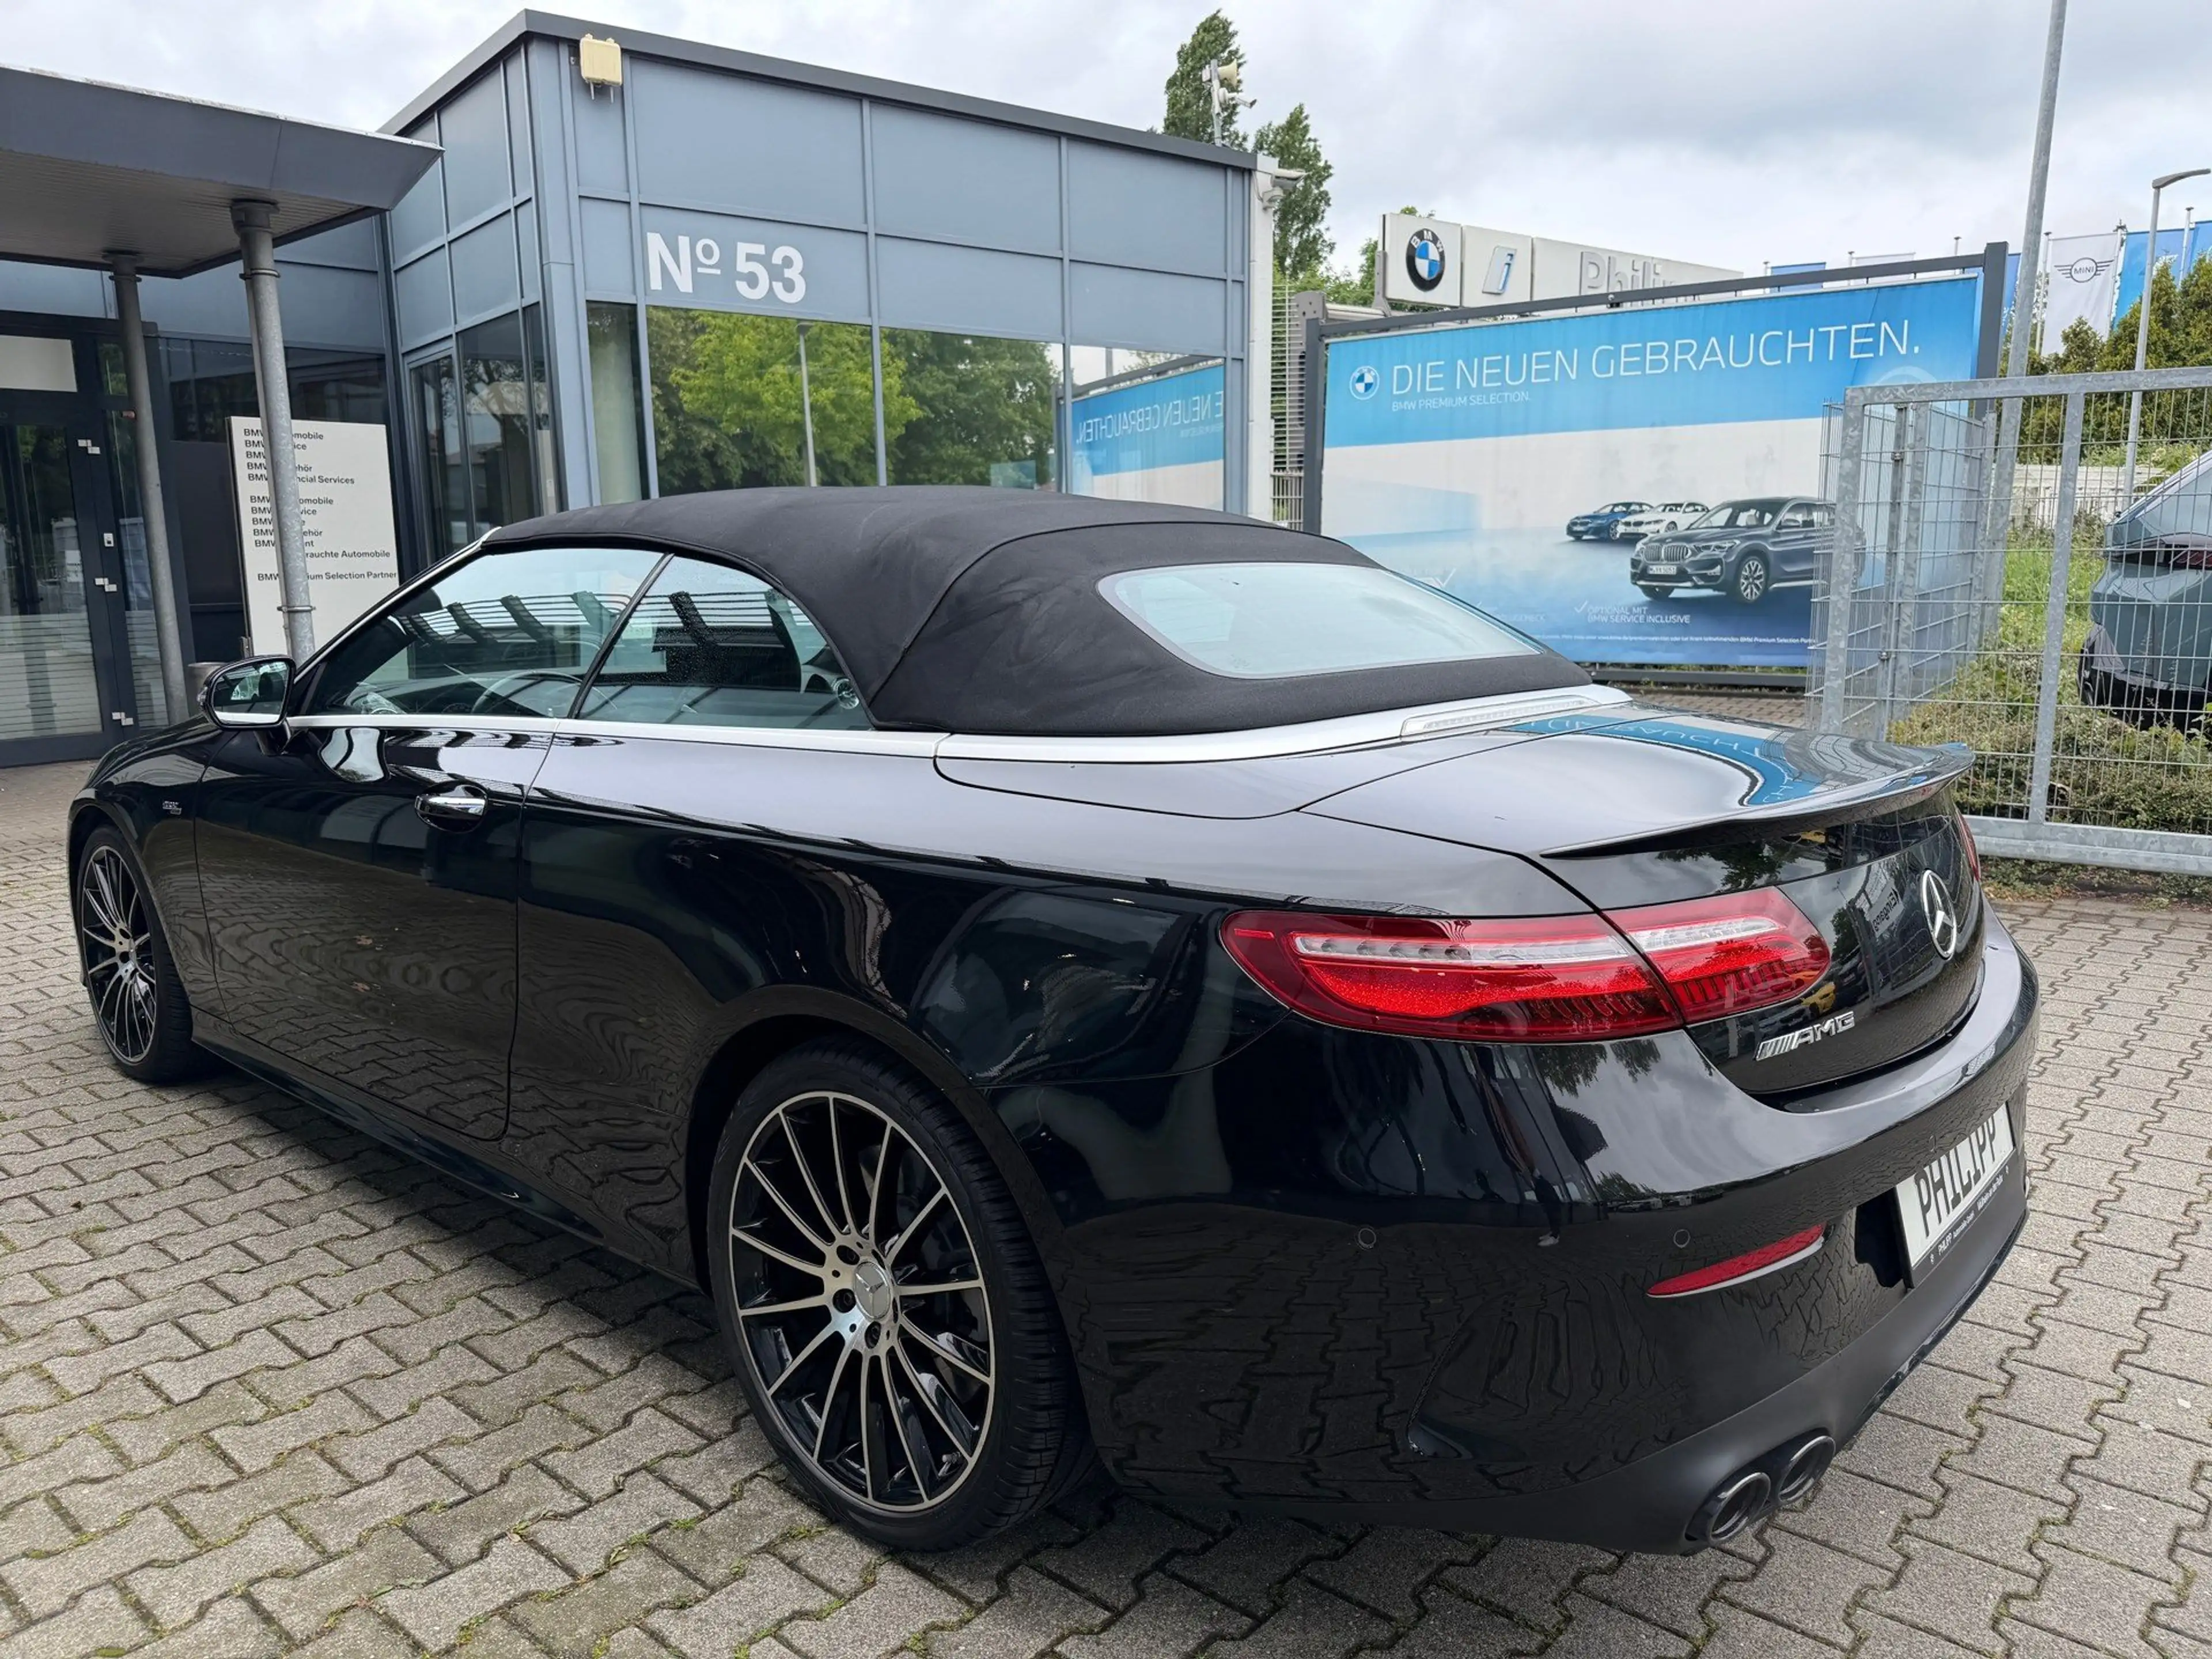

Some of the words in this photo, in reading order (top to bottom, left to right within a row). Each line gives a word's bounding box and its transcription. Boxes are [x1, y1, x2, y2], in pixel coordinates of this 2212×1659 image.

[734, 241, 806, 304] 53
[2074, 266, 2094, 275] MINI
[1392, 361, 1445, 395] DIE
[1456, 348, 1578, 389] NEUEN
[1592, 319, 1919, 378] GEBRAUCHTEN.
[1392, 401, 1417, 412] BMW
[1418, 396, 1468, 411] PREMIUM
[318, 475, 355, 484] Services
[341, 550, 391, 558] Automobile
[325, 571, 365, 580] Selection
[366, 571, 397, 579] Partner
[1587, 606, 1629, 615] OPTIONAL
[1633, 607, 1648, 615] MIT
[1610, 615, 1645, 623] SERVICE
[1646, 615, 1691, 624] INCLUSIVE
[1791, 1011, 1855, 1050] AMG
[1914, 1115, 1996, 1238] PHILIPP
